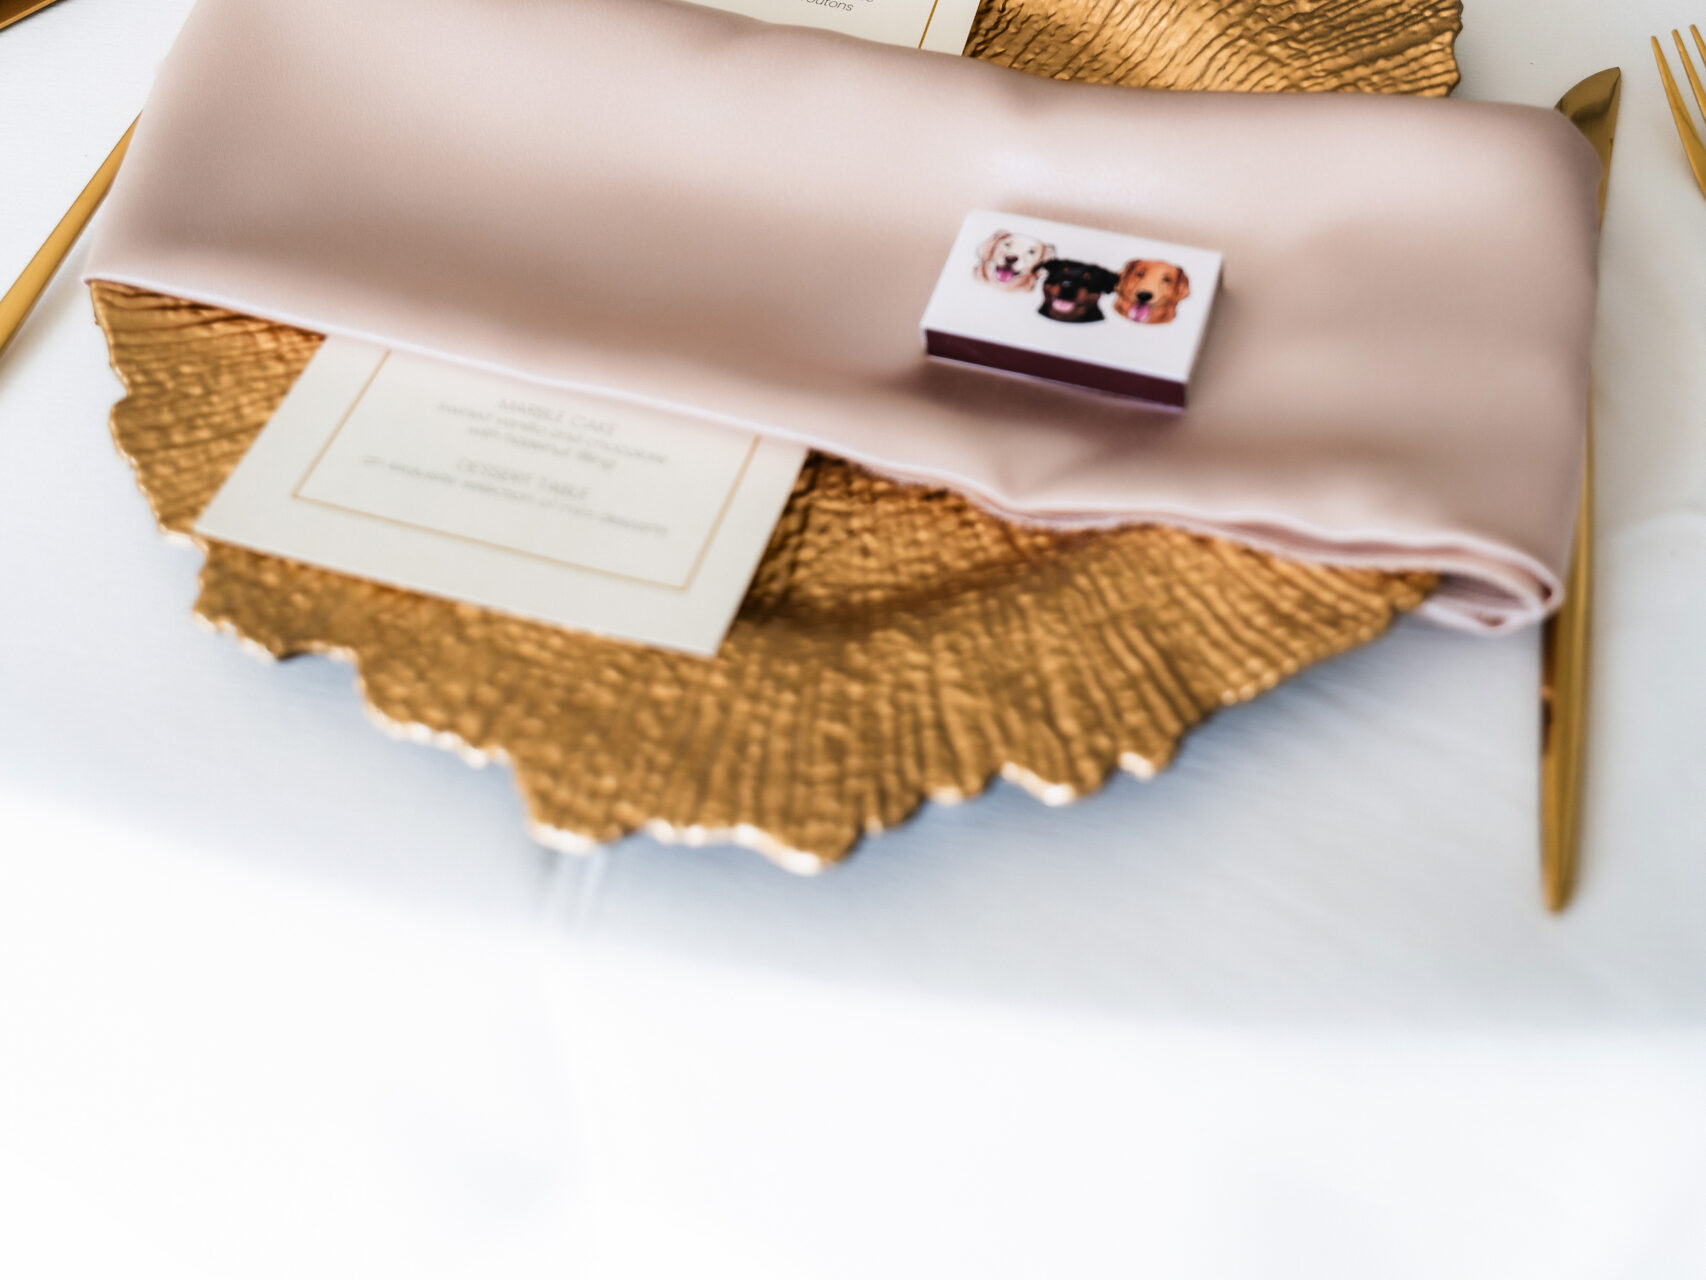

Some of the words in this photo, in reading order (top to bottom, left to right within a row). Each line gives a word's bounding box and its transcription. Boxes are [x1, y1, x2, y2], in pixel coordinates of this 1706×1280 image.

[499, 398, 565, 423] MARBLE
[570, 413, 619, 437] CAKE
[456, 455, 533, 484] DESSERT
